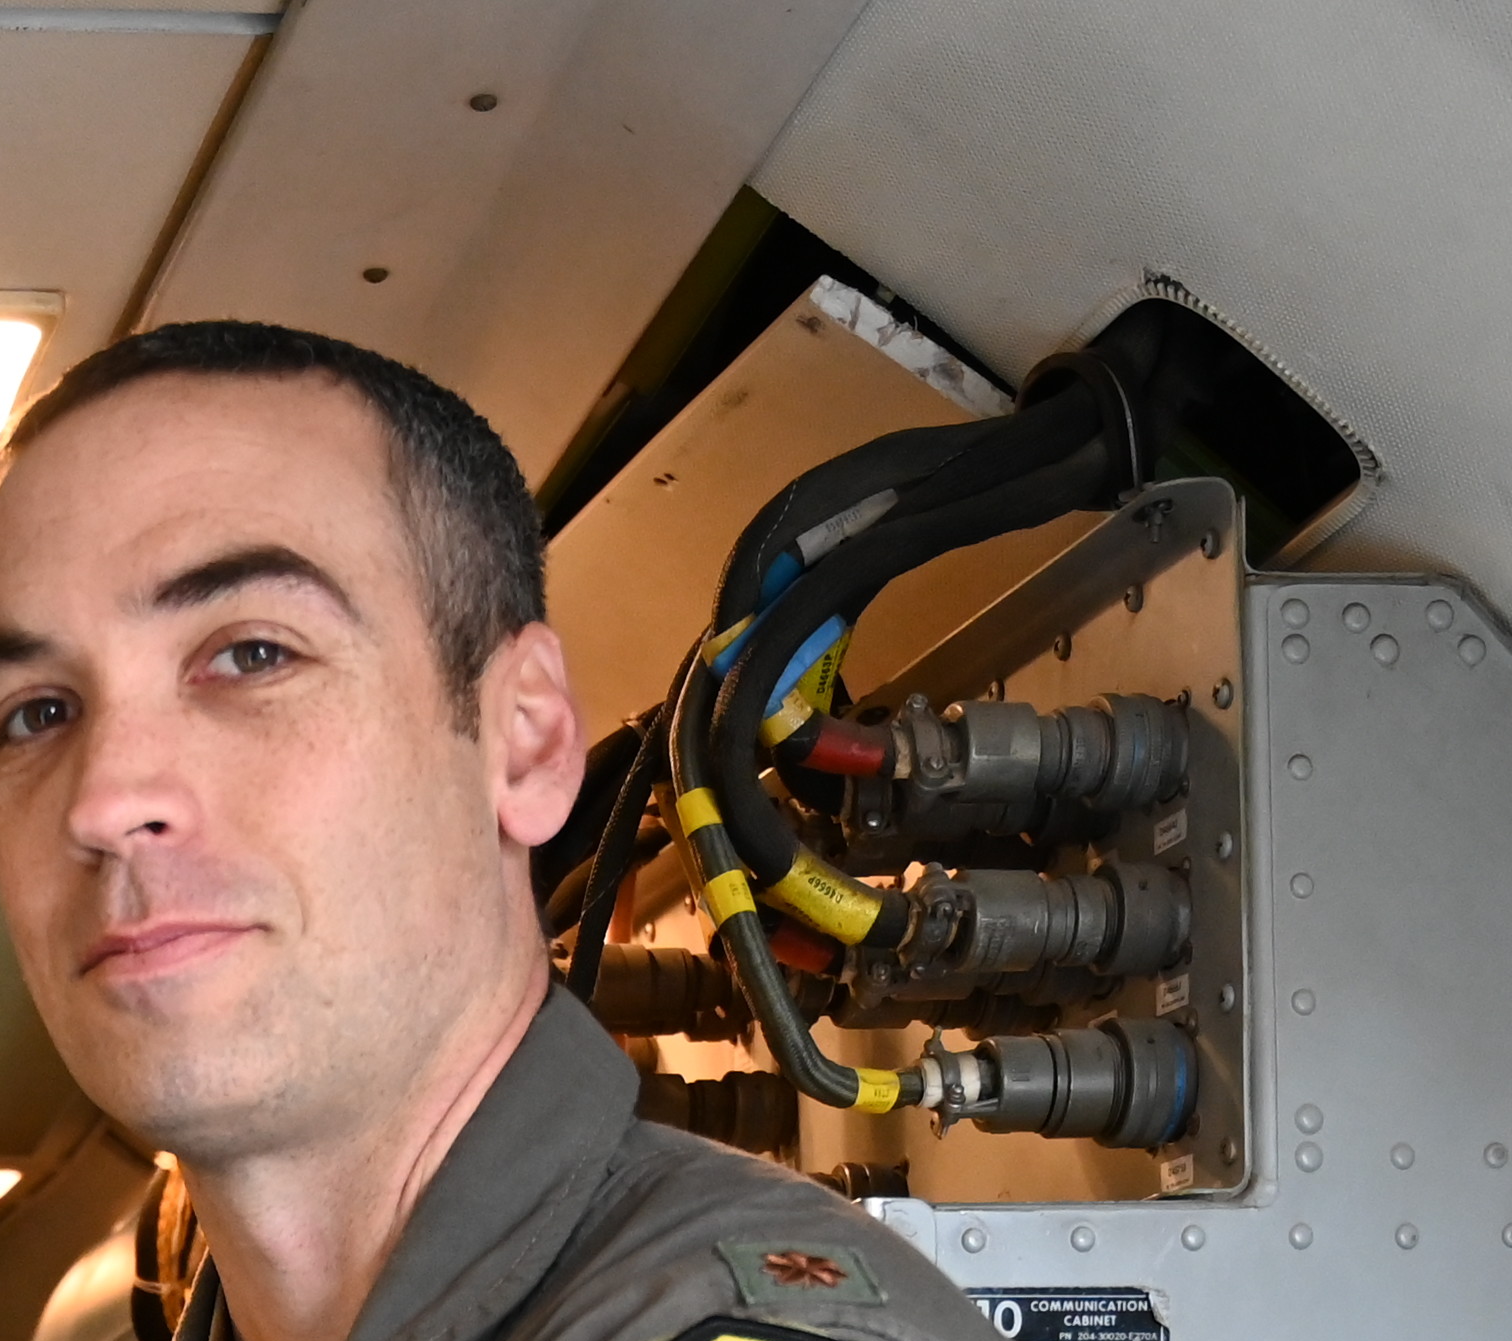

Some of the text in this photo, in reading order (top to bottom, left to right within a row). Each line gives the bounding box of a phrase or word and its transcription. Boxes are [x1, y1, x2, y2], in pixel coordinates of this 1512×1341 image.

[974, 1299, 1023, 1339] 10
[1064, 1315, 1117, 1327] CABINET
[1059, 1332, 1072, 1341] PN
